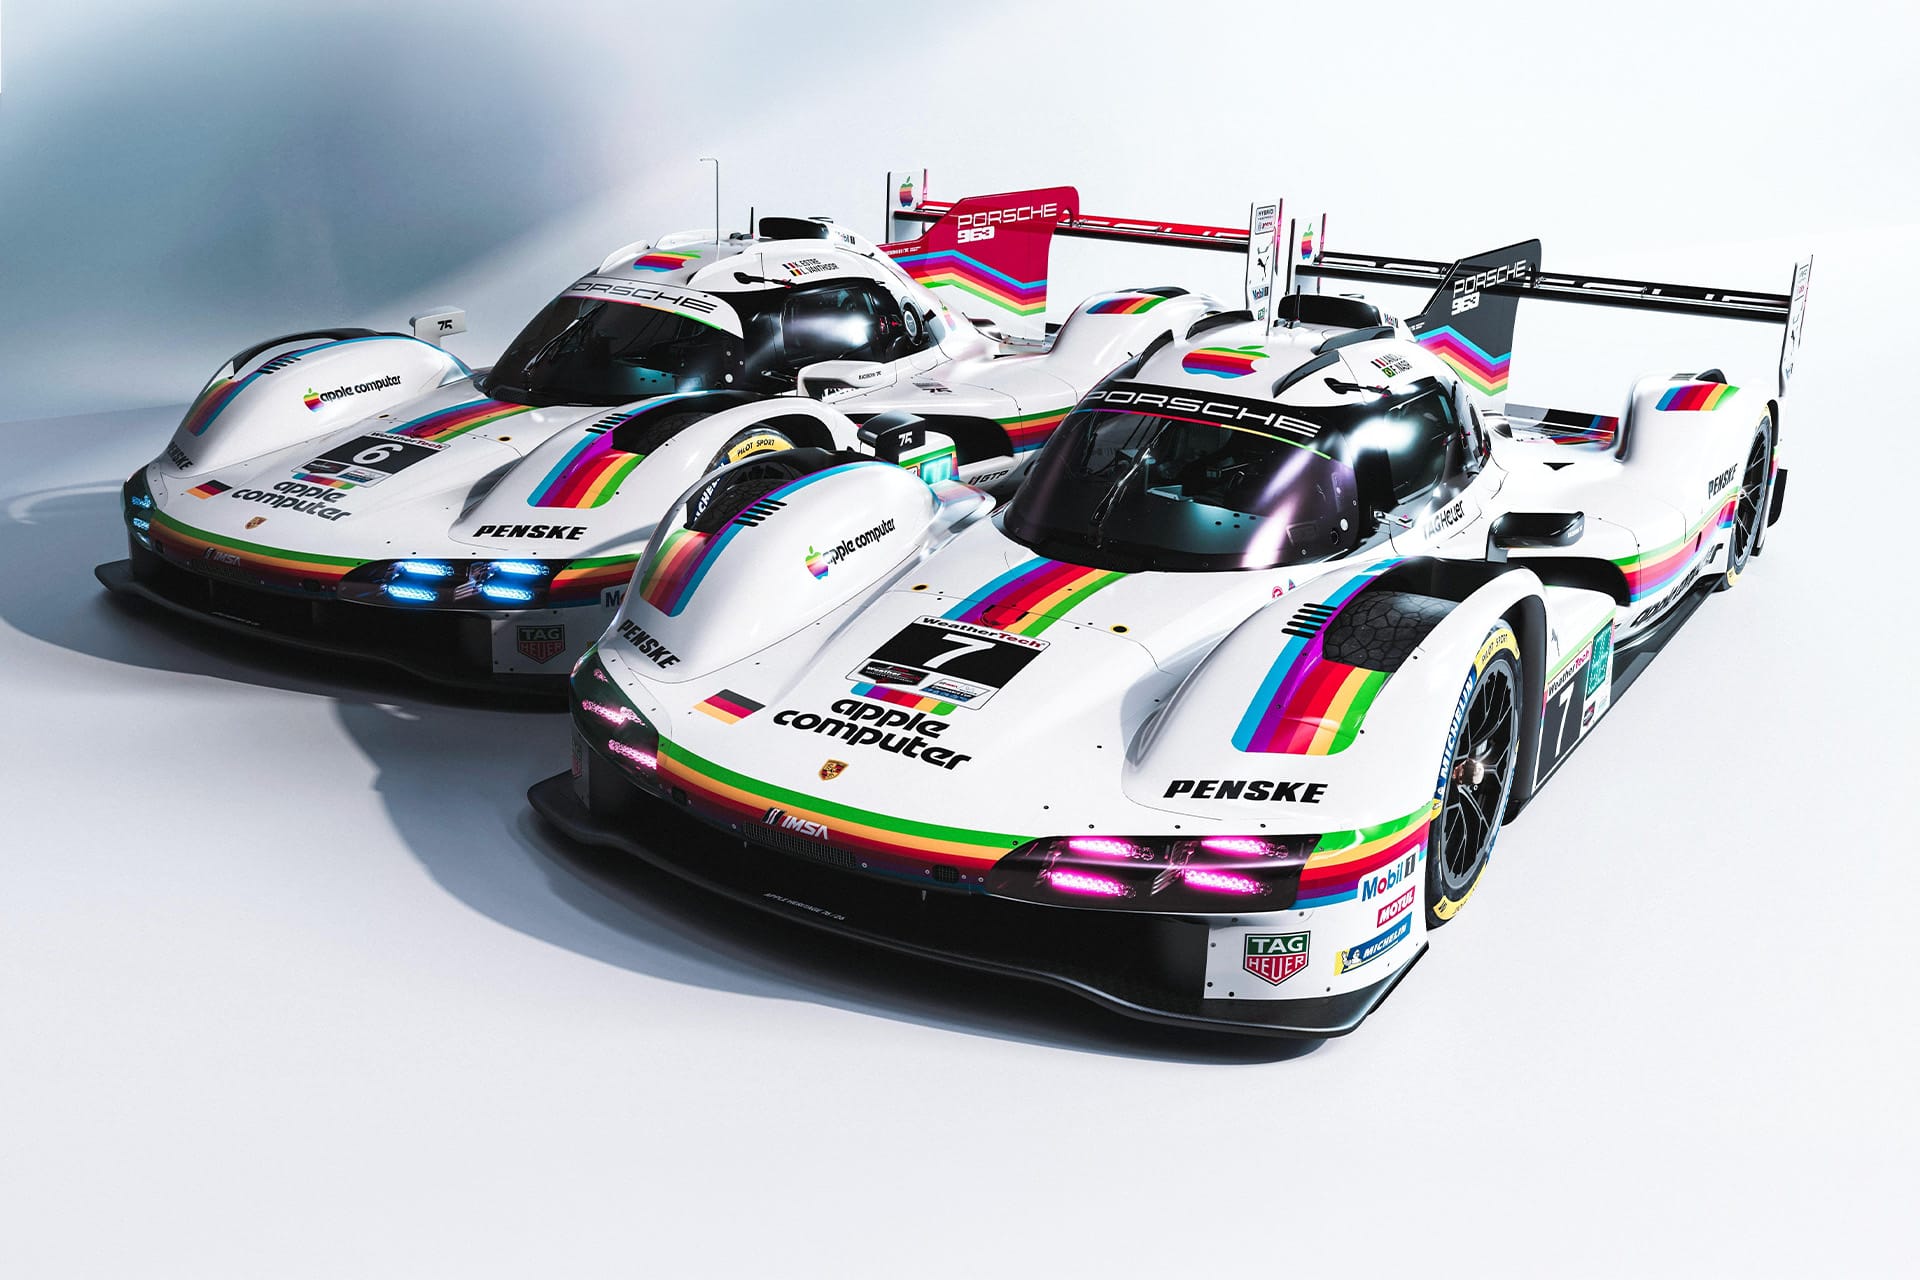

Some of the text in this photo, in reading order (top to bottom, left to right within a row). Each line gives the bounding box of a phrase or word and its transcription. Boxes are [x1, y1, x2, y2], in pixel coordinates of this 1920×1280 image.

[957, 203, 1058, 229] PORSCHE
[957, 226, 994, 243] 963
[1453, 259, 1526, 298] PORSCHE
[1451, 292, 1480, 315] 963
[437, 319, 453, 331] 75
[320, 375, 401, 403] apple computer
[736, 438, 775, 457] PILOT SPORT
[898, 431, 913, 447] 75
[167, 441, 194, 470] PENSKE
[352, 443, 404, 465] 6
[980, 470, 1009, 483] GTP
[1708, 463, 1738, 500] PENSKE
[231, 489, 352, 521] computer
[273, 481, 347, 503] apple
[473, 525, 587, 540] PENSKE
[822, 518, 896, 565] apple computer
[521, 629, 560, 640] TAG
[617, 619, 681, 669] PENSKE
[922, 617, 1042, 649] WeatherTech
[520, 642, 562, 660] HEUER
[922, 633, 997, 669] 7
[1548, 650, 1589, 696] WeatherTech
[831, 699, 950, 738] apple
[1439, 676, 1475, 778] MICHELIN
[1555, 681, 1575, 758] 7
[773, 710, 972, 770] computer
[1163, 780, 1328, 803] PENSKE
[781, 815, 828, 840] IMSA
[1361, 854, 1416, 902] Mobil 1
[1379, 891, 1414, 925] MOTUL
[1252, 937, 1303, 954] TAG
[1363, 923, 1408, 959] MICHELIN
[1249, 955, 1305, 980] HEUER
